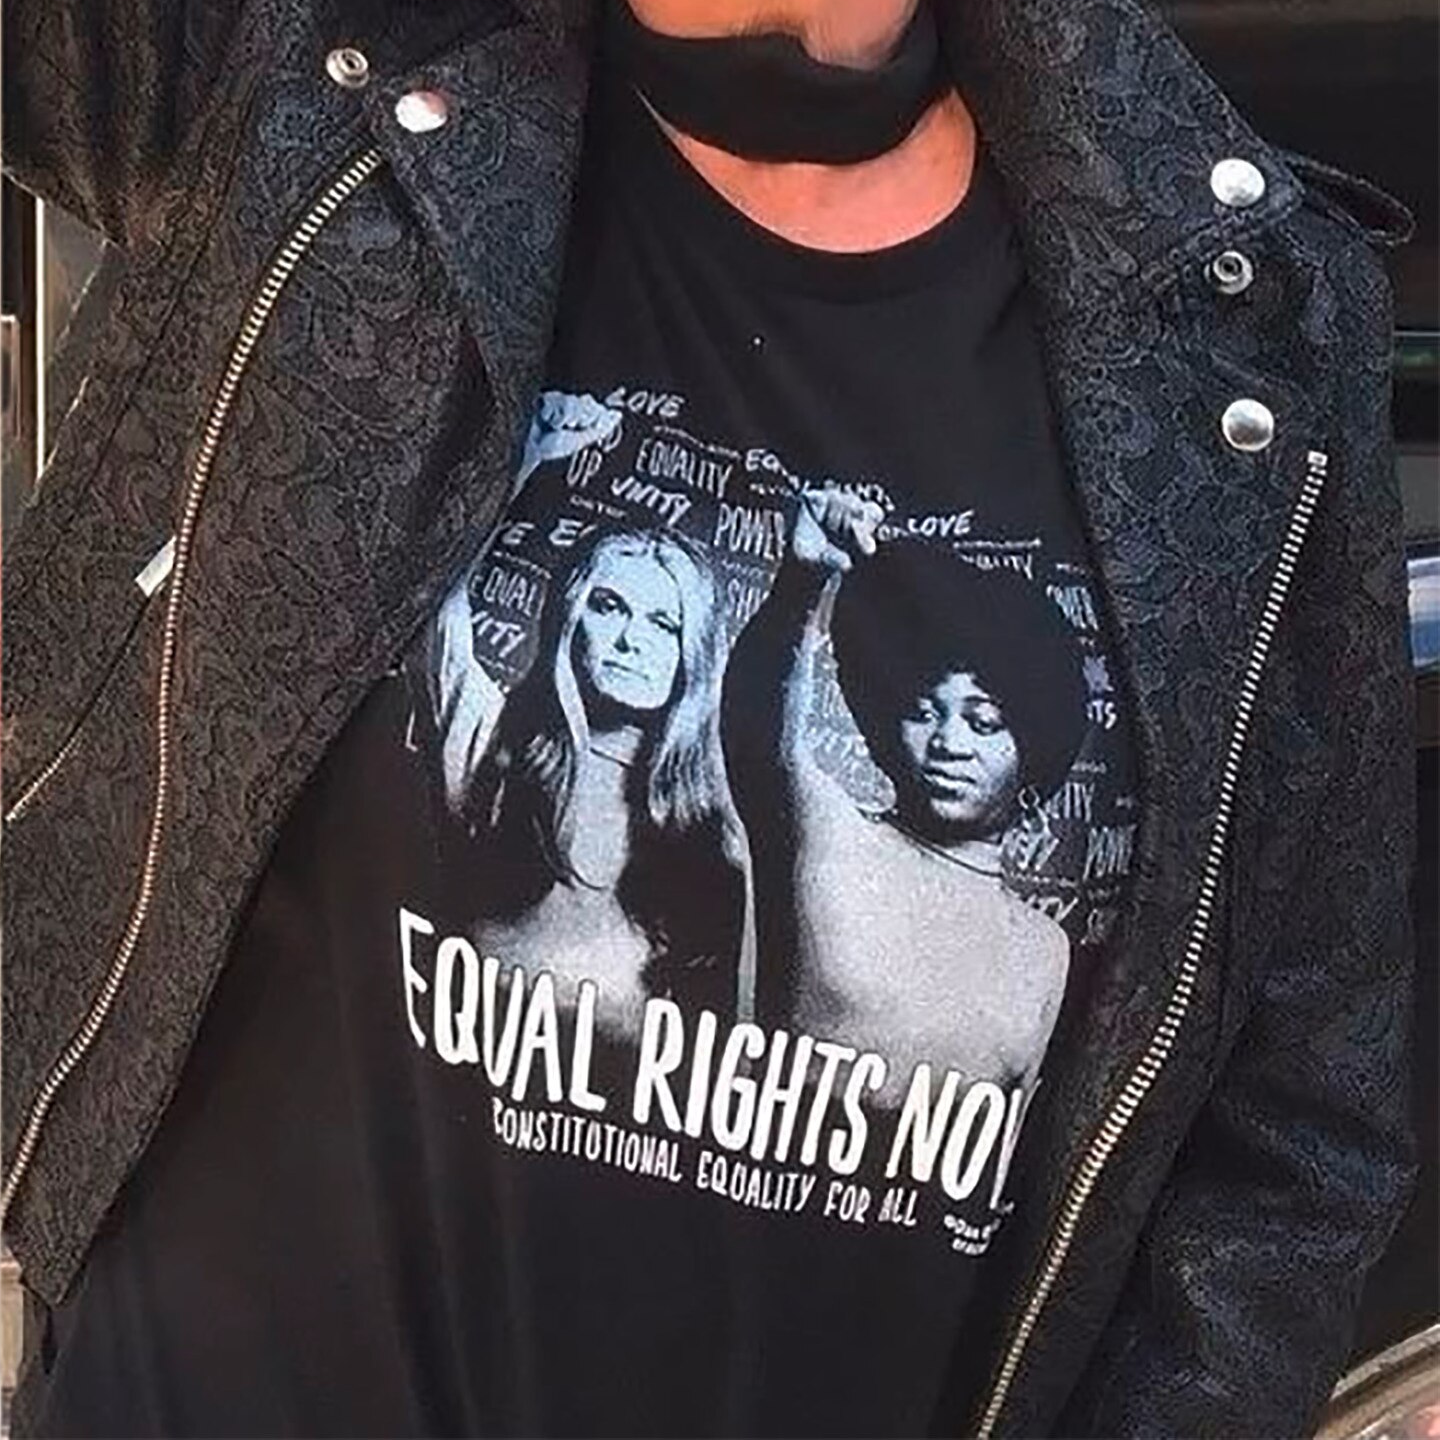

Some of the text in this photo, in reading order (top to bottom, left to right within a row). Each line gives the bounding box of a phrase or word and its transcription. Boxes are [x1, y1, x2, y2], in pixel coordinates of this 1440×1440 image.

[605, 386, 685, 418] LOVE
[635, 438, 734, 498] EQUALITY
[398, 906, 607, 1112] EQUAL
[632, 997, 887, 1178] RIGHTS
[492, 1096, 683, 1184] CONSTITUTIONAL
[696, 1150, 817, 1213] EQUALITY
[823, 1181, 870, 1224] FOR
[878, 1188, 918, 1227] ALL
